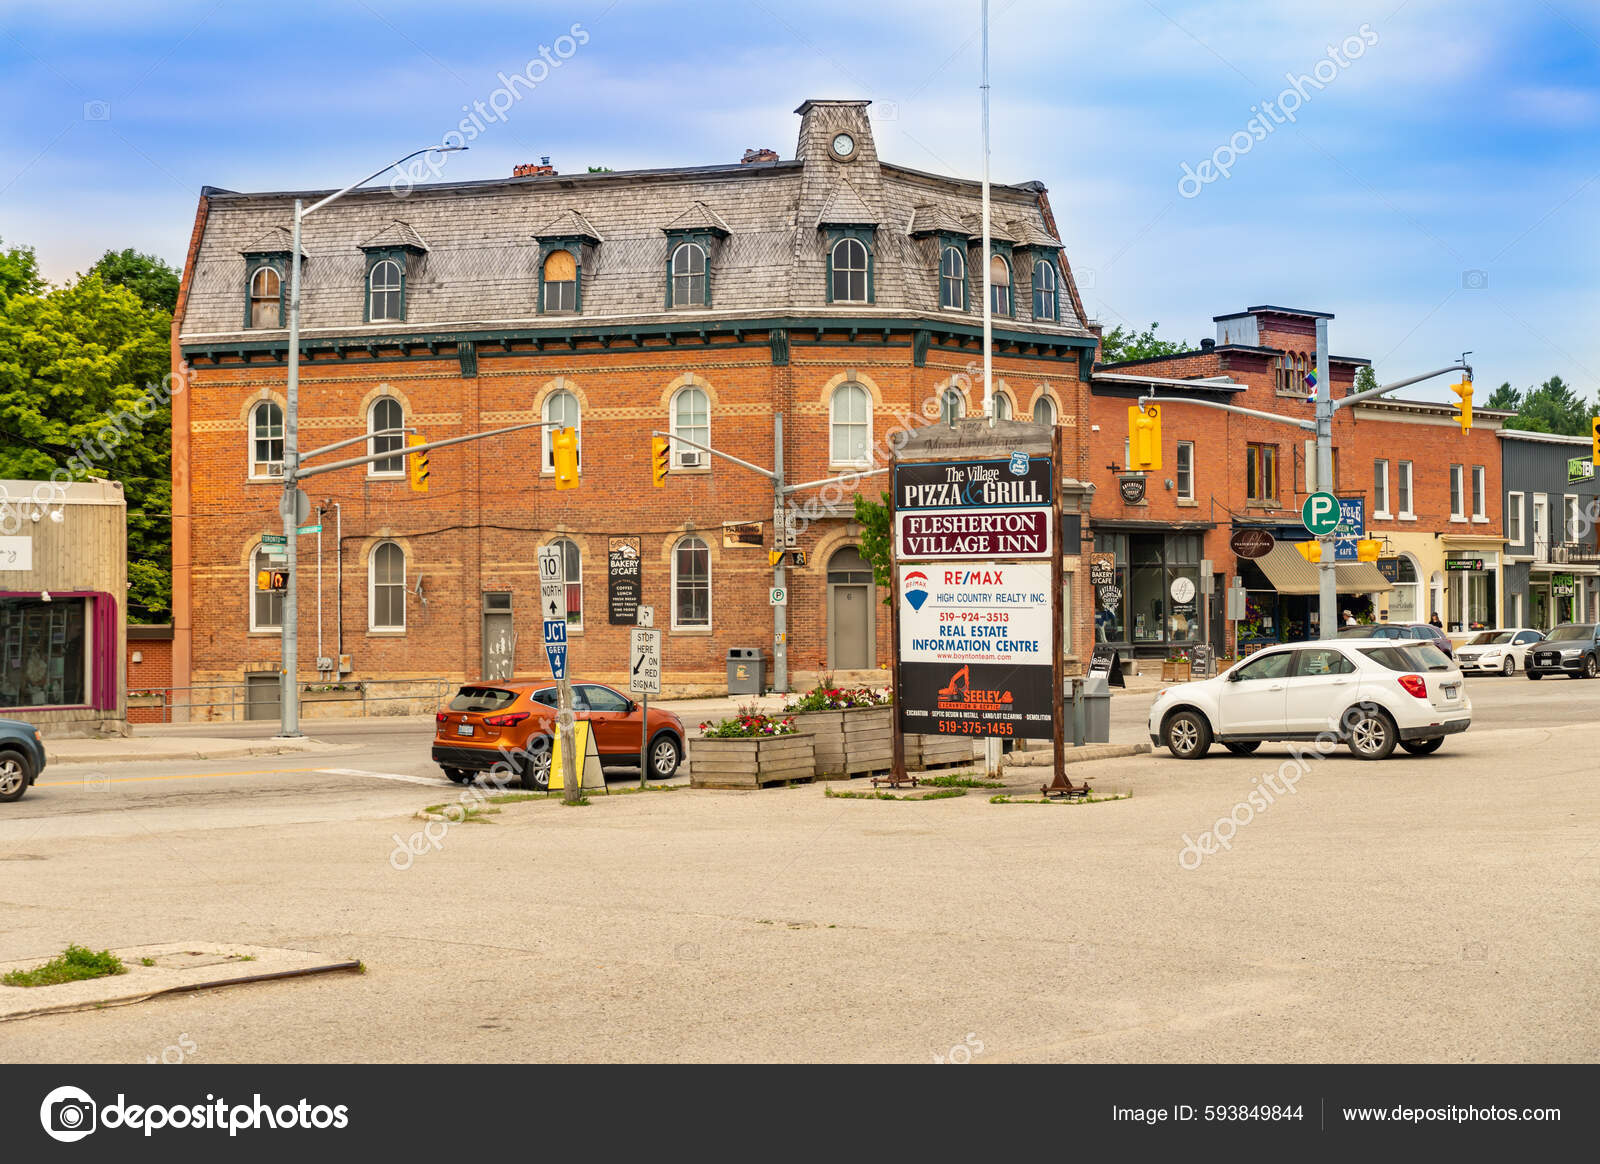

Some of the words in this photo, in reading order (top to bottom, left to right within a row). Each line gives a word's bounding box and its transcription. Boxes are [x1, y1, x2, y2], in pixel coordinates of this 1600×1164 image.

[946, 467, 964, 482] The
[967, 465, 1000, 484] Village
[904, 483, 962, 506] PIZZA
[983, 480, 1043, 504] GRILL
[1312, 497, 1332, 526] P
[909, 514, 1036, 534] FLESHERTON
[907, 536, 991, 553] VILLAGE
[997, 534, 1039, 552] INN
[543, 558, 557, 575] 10
[610, 560, 639, 568] BAKERY
[944, 571, 1003, 585] RE/MAX
[542, 585, 561, 597] NORTH
[936, 593, 955, 603] HIGH
[957, 593, 992, 603] COUNTRY
[996, 593, 1027, 603] REALTY
[1030, 593, 1047, 603] INC.
[939, 612, 1009, 622] 519-924-3513
[546, 622, 564, 640] JCT
[939, 625, 966, 637] REAL
[971, 625, 1008, 637] ESTATE
[637, 633, 654, 642] STOP
[549, 646, 565, 654] GREY
[637, 645, 654, 654] HERE
[912, 638, 990, 652] INFORMATION
[996, 640, 1039, 652] CENTRE
[554, 655, 561, 667] 4
[648, 658, 657, 666] ON
[937, 652, 1012, 661] www.boyntonteam.com
[645, 669, 657, 677] RED
[633, 680, 657, 689] SIGNAL
[963, 690, 1001, 703] SEELEY
[938, 720, 1013, 735] 519-375-1455
